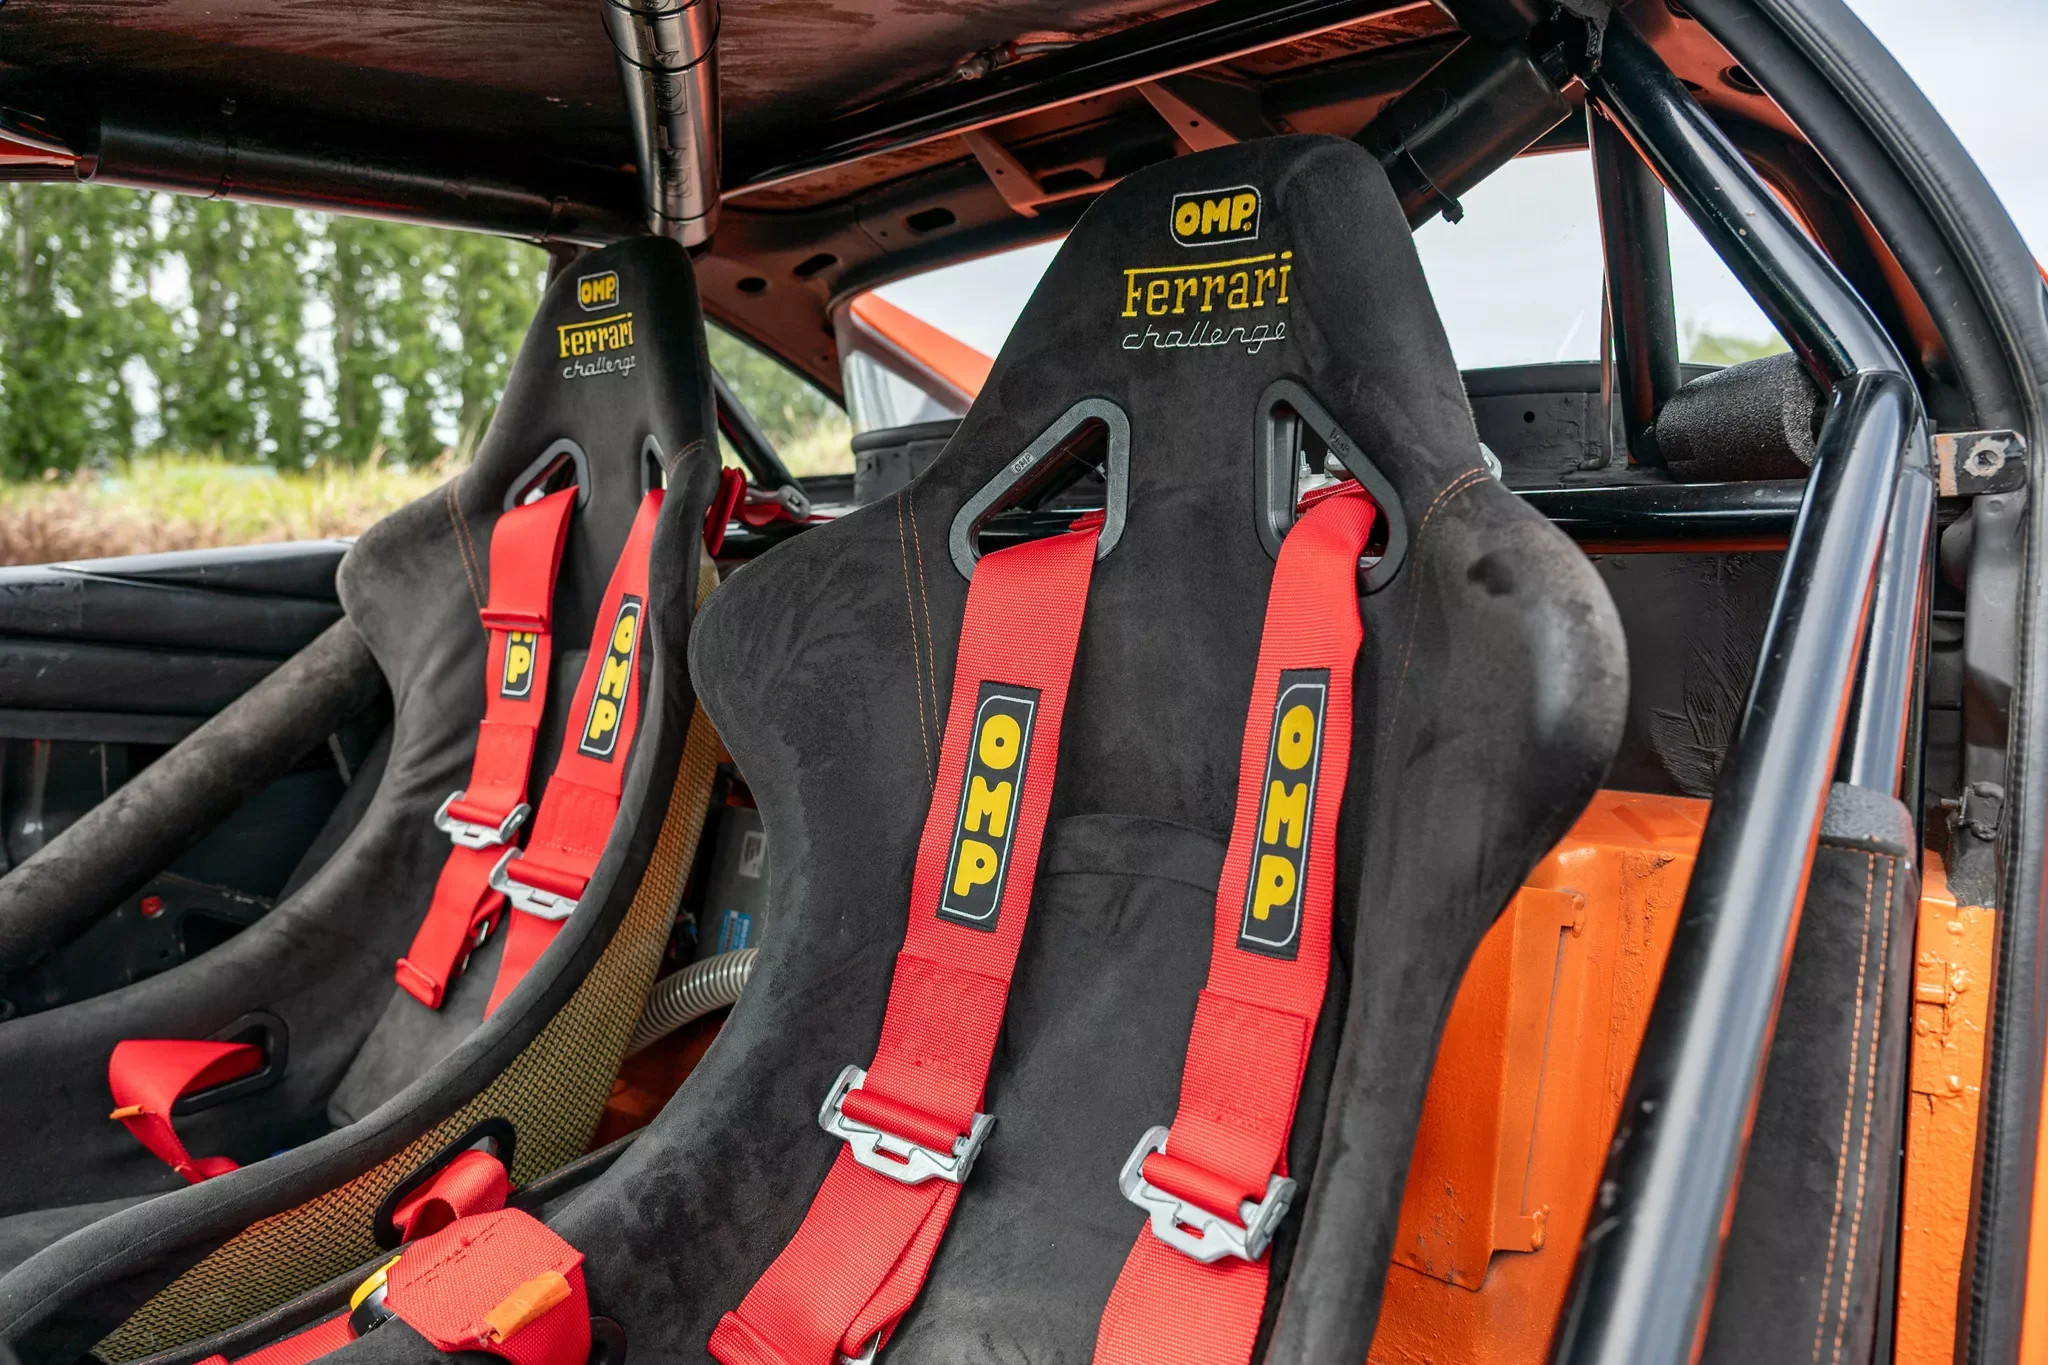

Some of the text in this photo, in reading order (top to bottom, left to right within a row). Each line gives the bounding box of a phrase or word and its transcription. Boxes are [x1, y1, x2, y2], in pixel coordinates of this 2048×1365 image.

[1175, 192, 1257, 236] OMP
[581, 275, 616, 304] OMP
[1121, 250, 1293, 318] Ferrari
[557, 312, 634, 358] Ferrari
[1121, 320, 1286, 354] challenge
[1014, 454, 1031, 472] OMP
[588, 615, 636, 740] OMP
[953, 714, 1021, 897] OMP
[1253, 704, 1315, 921] OMP
